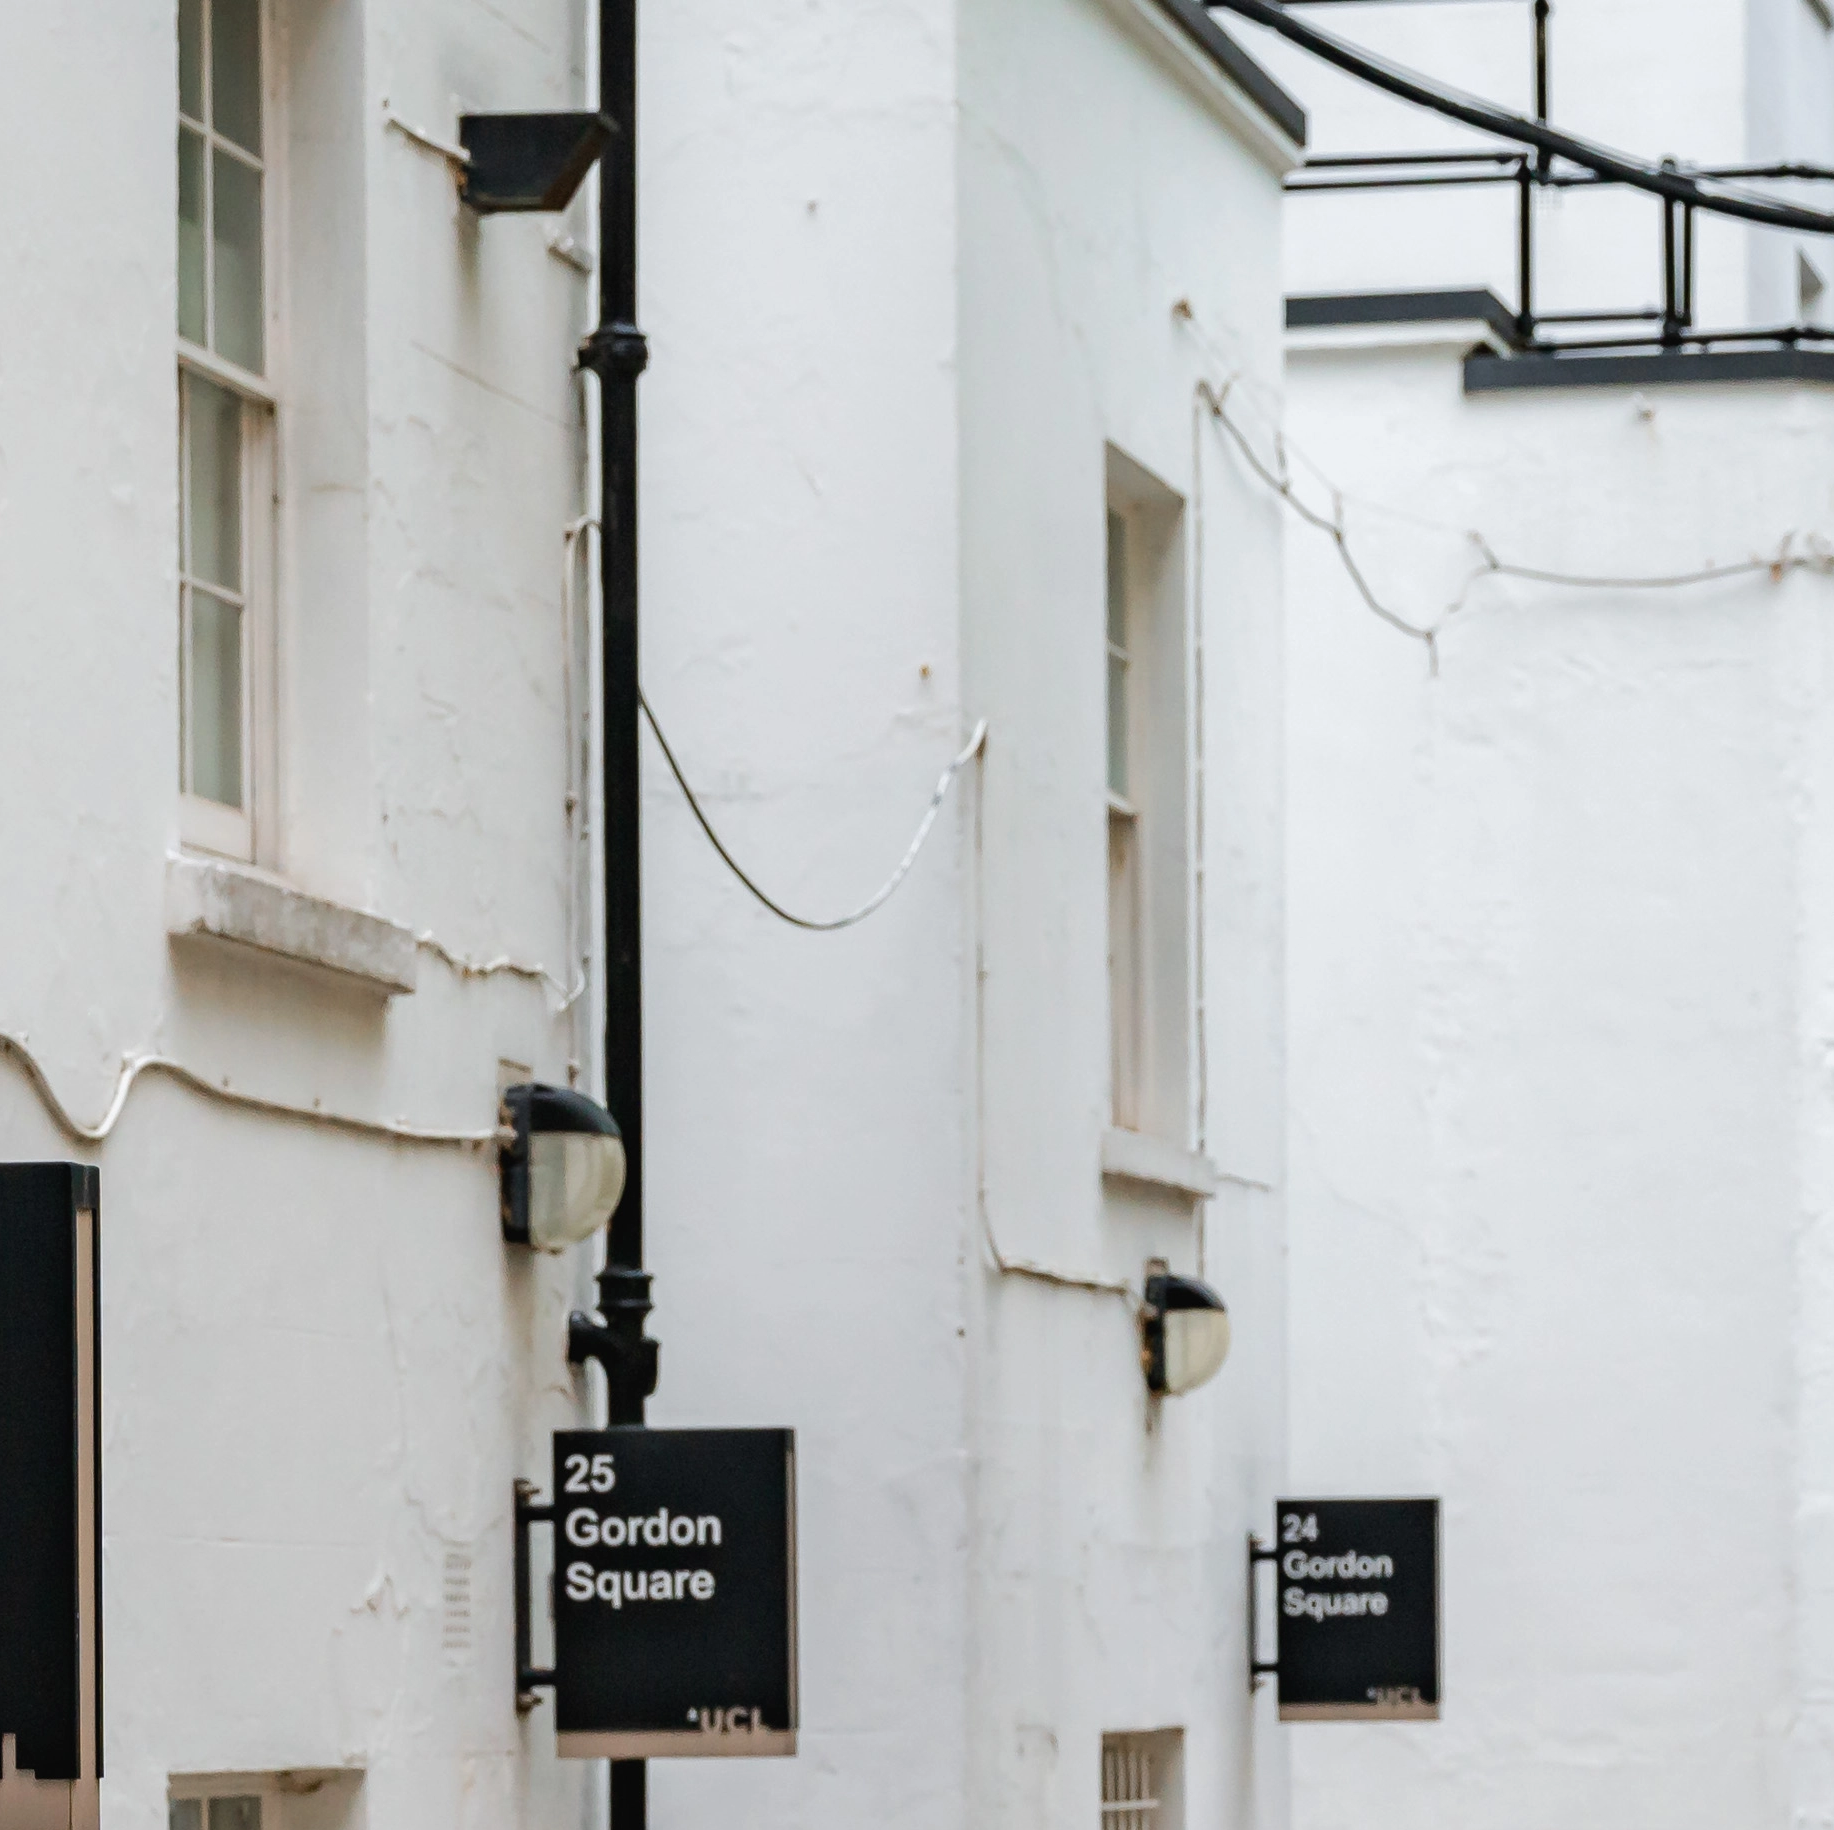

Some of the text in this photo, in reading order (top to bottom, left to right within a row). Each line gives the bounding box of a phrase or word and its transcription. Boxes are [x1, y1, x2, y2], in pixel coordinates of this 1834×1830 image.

[564, 1454, 617, 1493] 25
[565, 1507, 722, 1547] Gordon
[1282, 1513, 1320, 1543] 24
[1282, 1549, 1394, 1580] Gordon
[565, 1561, 716, 1610] Square
[1283, 1586, 1389, 1623] Square
[700, 1705, 770, 1734] UCL
